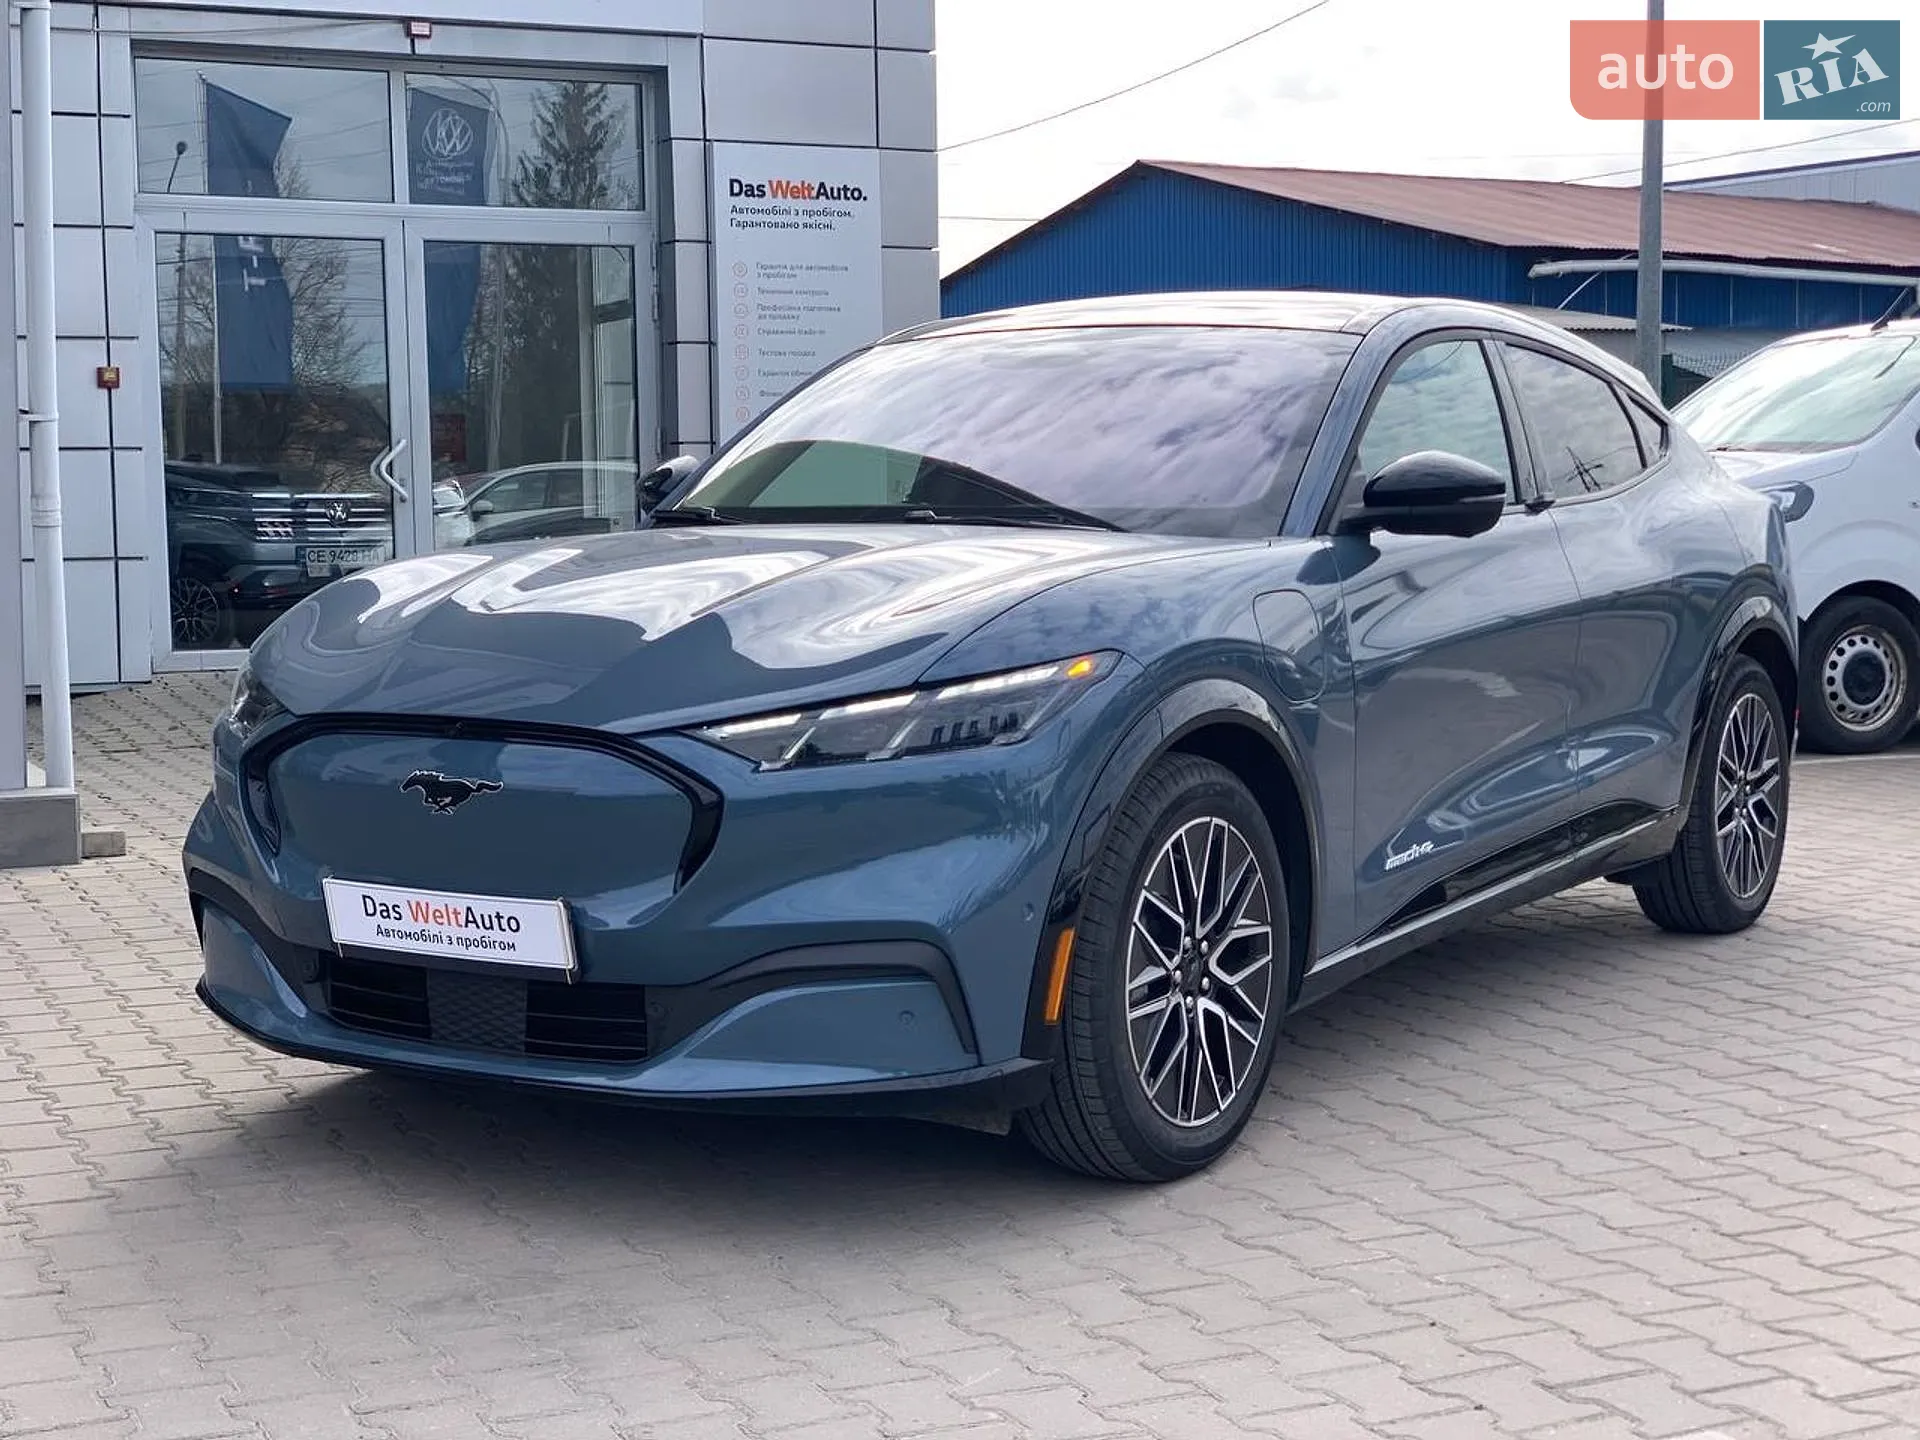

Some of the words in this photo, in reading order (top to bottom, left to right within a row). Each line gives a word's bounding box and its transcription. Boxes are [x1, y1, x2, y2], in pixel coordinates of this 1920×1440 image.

[729, 179, 766, 198] Das
[730, 204, 792, 216] Автомобілі
[730, 218, 800, 230] Гарантовано
[307, 550, 327, 563] CE
[362, 894, 402, 921] Das
[406, 899, 521, 933] WeltAuto
[376, 924, 444, 945] Автомобілі
[446, 935, 454, 946] з
[456, 934, 516, 951] пробігом
